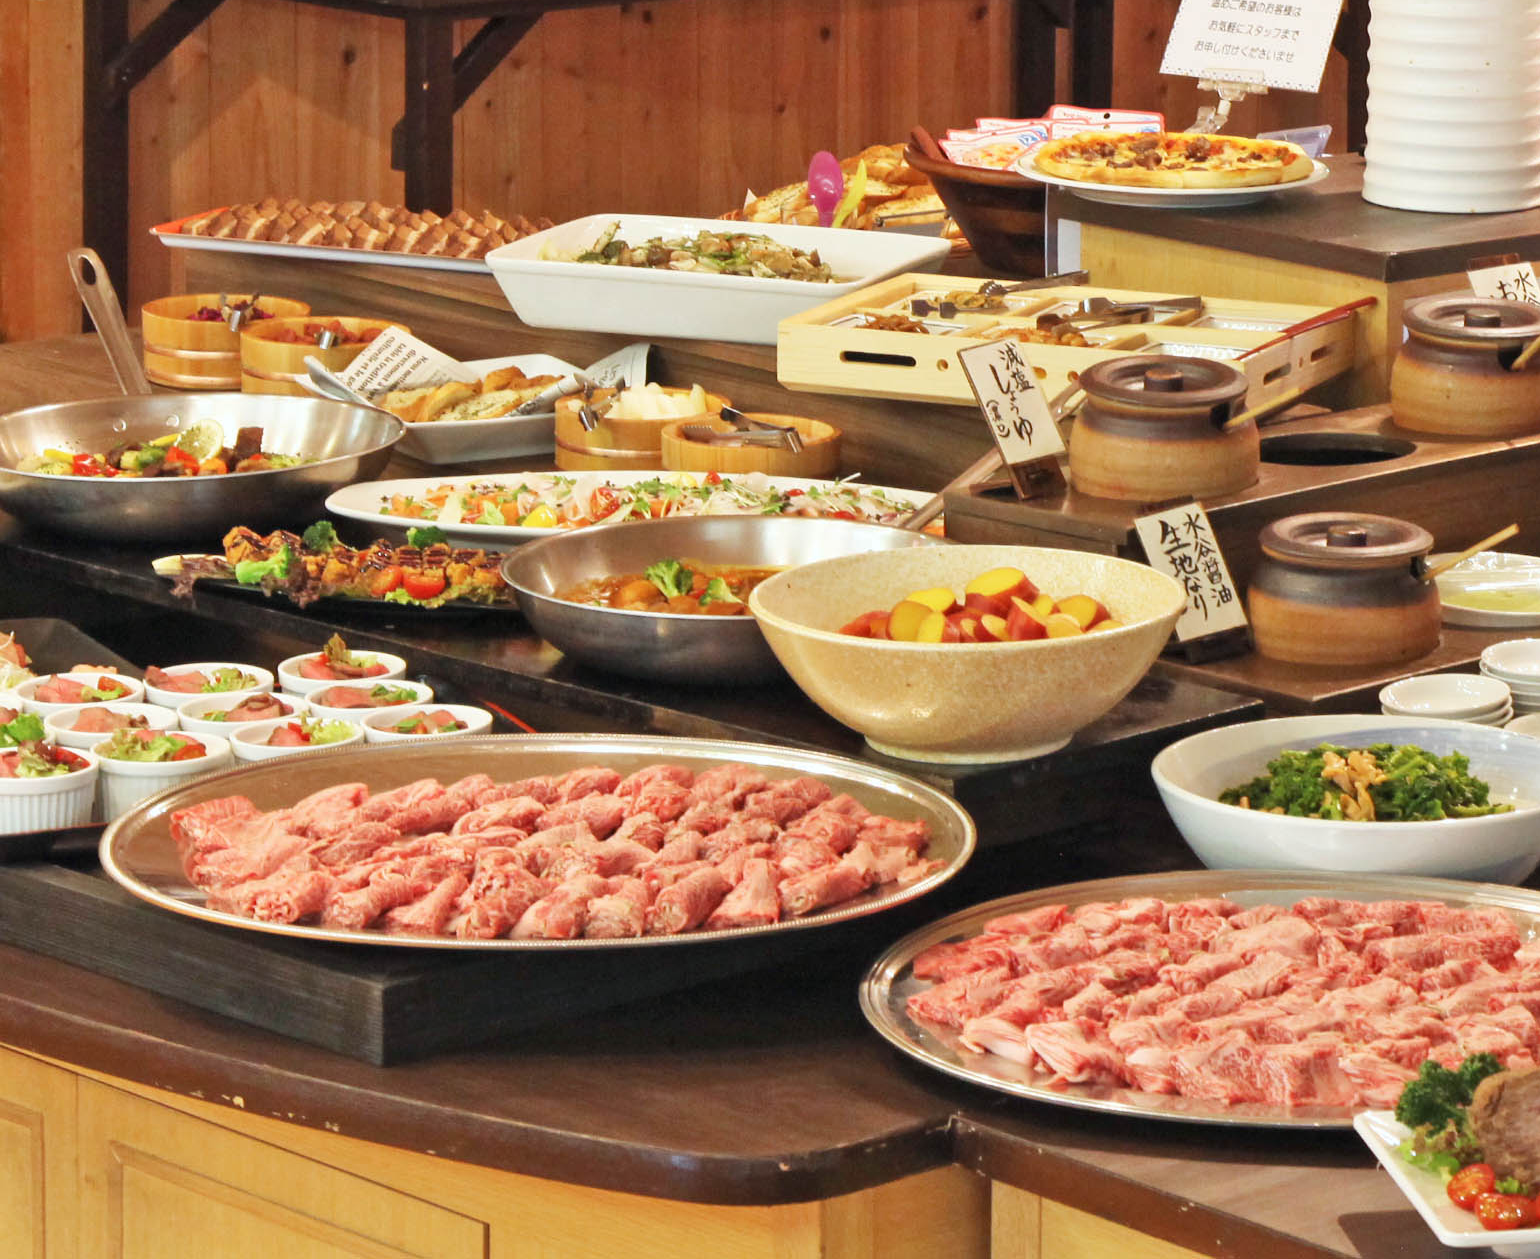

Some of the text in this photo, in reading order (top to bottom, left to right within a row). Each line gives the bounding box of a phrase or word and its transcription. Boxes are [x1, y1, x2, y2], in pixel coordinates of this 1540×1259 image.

[988, 363, 1033, 447] しょうゆ
[1182, 512, 1233, 608] 水谷醤油
